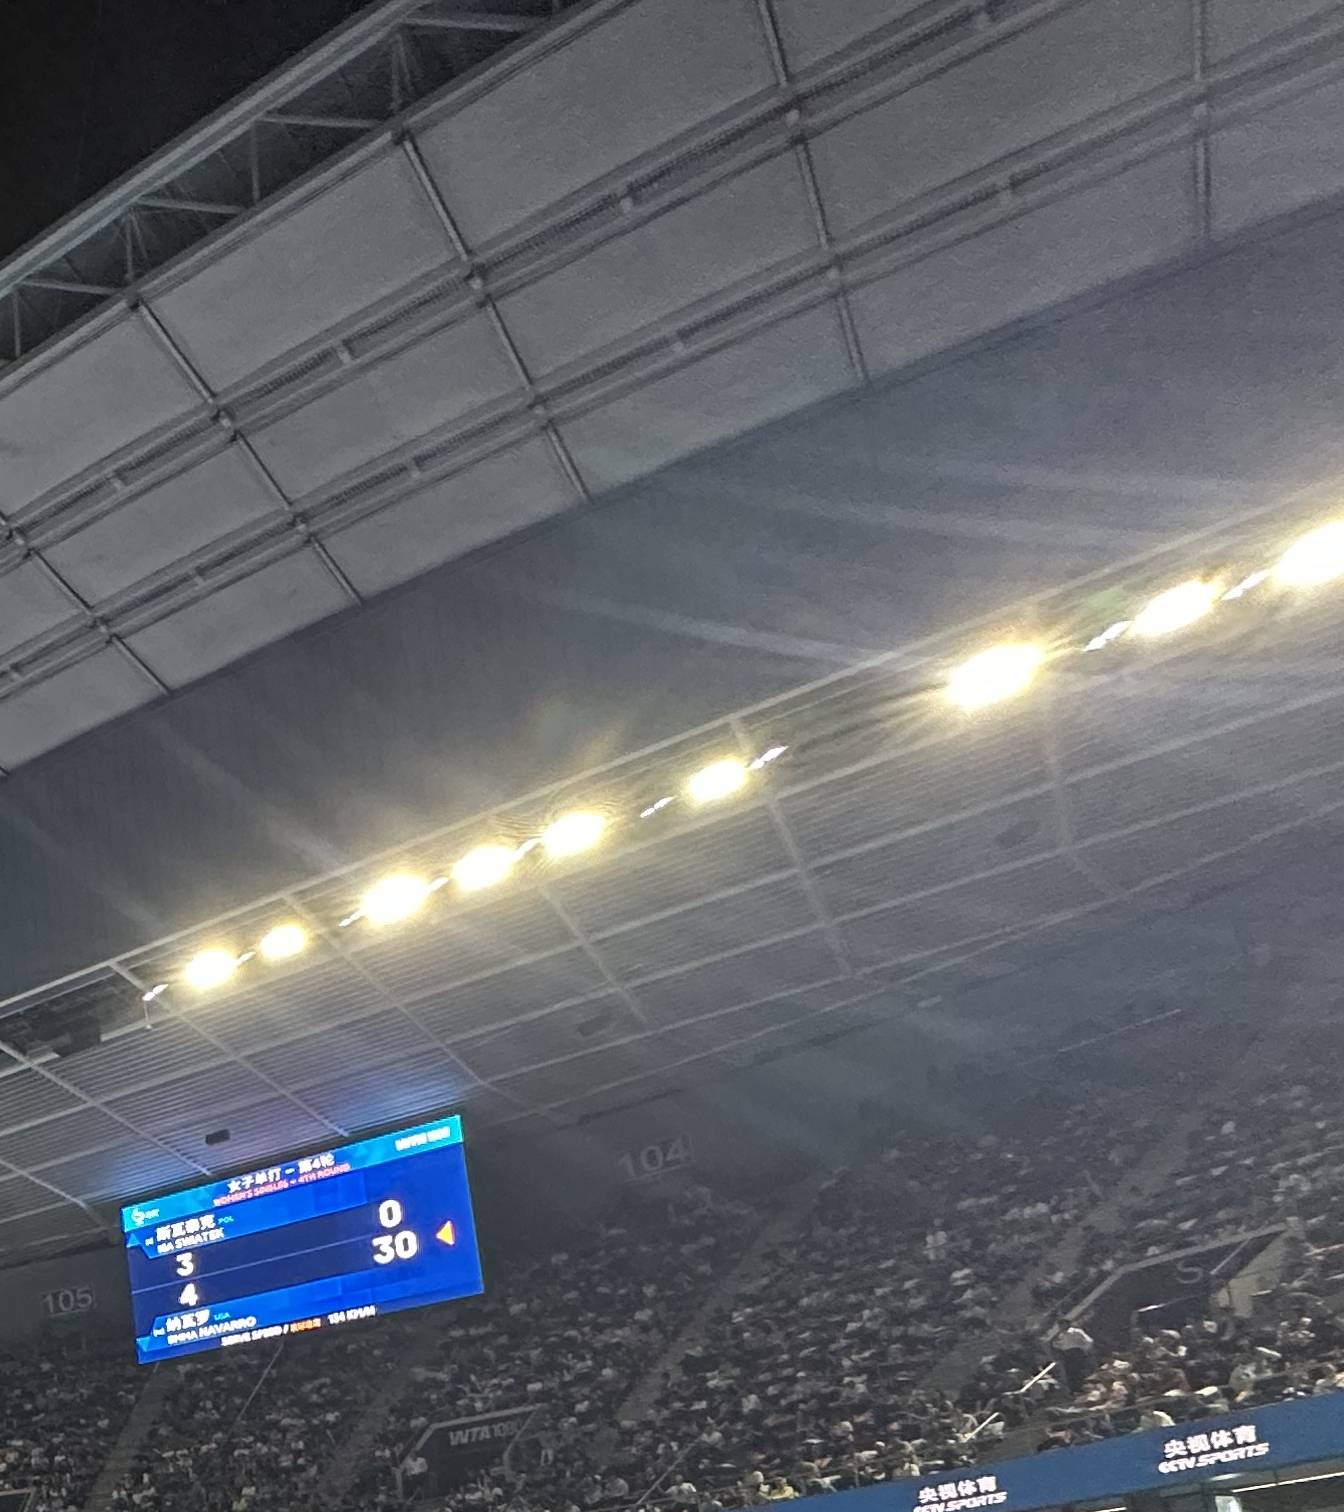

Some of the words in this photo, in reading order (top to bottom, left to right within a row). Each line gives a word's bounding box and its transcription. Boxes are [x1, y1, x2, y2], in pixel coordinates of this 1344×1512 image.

[379, 1200, 402, 1228] 0
[372, 1231, 419, 1264] 30
[176, 1252, 194, 1276] 3
[41, 1287, 93, 1313] 105
[179, 1283, 198, 1306] 4
[1164, 1425, 1256, 1458] 央视体育
[1158, 1457, 1196, 1473] CCTV
[1196, 1443, 1269, 1467] SPORTS
[919, 1476, 996, 1503] 央视体育
[945, 1492, 1007, 1511] SPORTS
